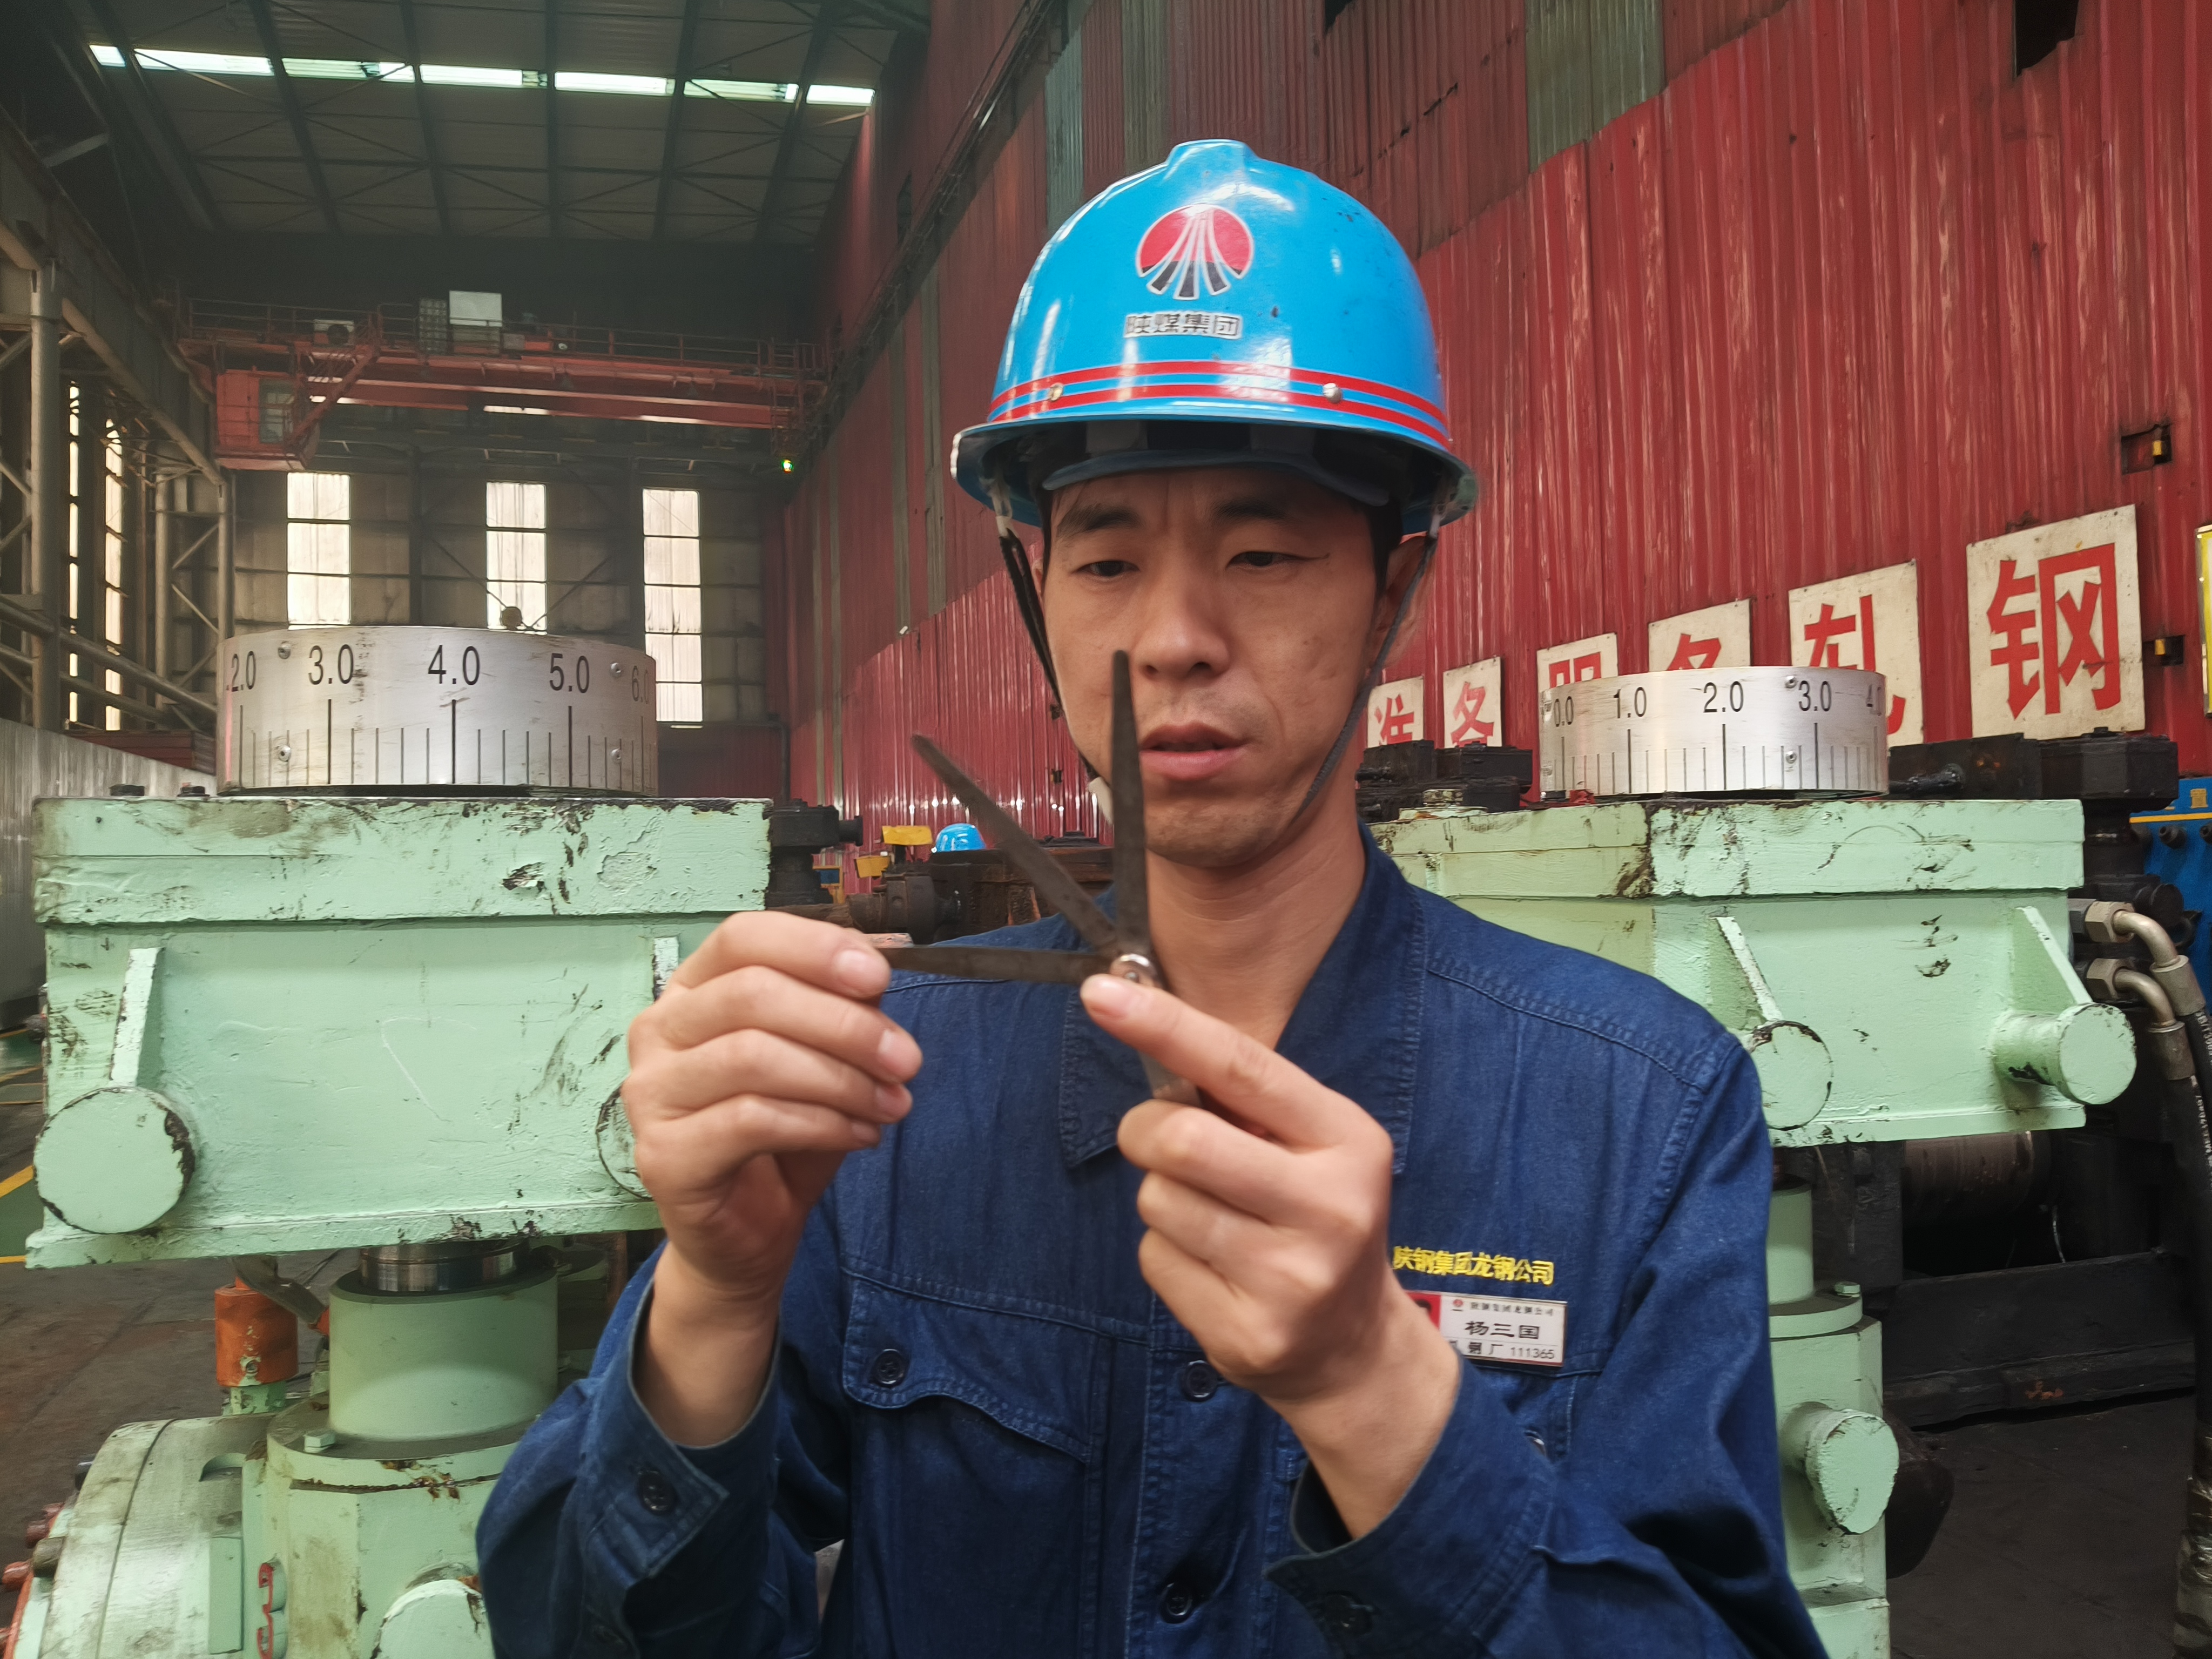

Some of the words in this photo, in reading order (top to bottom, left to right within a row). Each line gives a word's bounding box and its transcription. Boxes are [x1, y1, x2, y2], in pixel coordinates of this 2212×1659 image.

[1125, 312, 1241, 337] 陕煤集团
[231, 651, 256, 692] 2.0
[308, 644, 354, 685] 3.0
[428, 645, 480, 685] 4.0
[550, 653, 590, 693] 5.0
[1554, 696, 1574, 727] 0.0
[1614, 687, 1647, 719] 1.0
[1704, 681, 1744, 713] 2.0
[1799, 680, 1831, 712] 3.0
[1465, 1320, 1540, 1339] 杨三国
